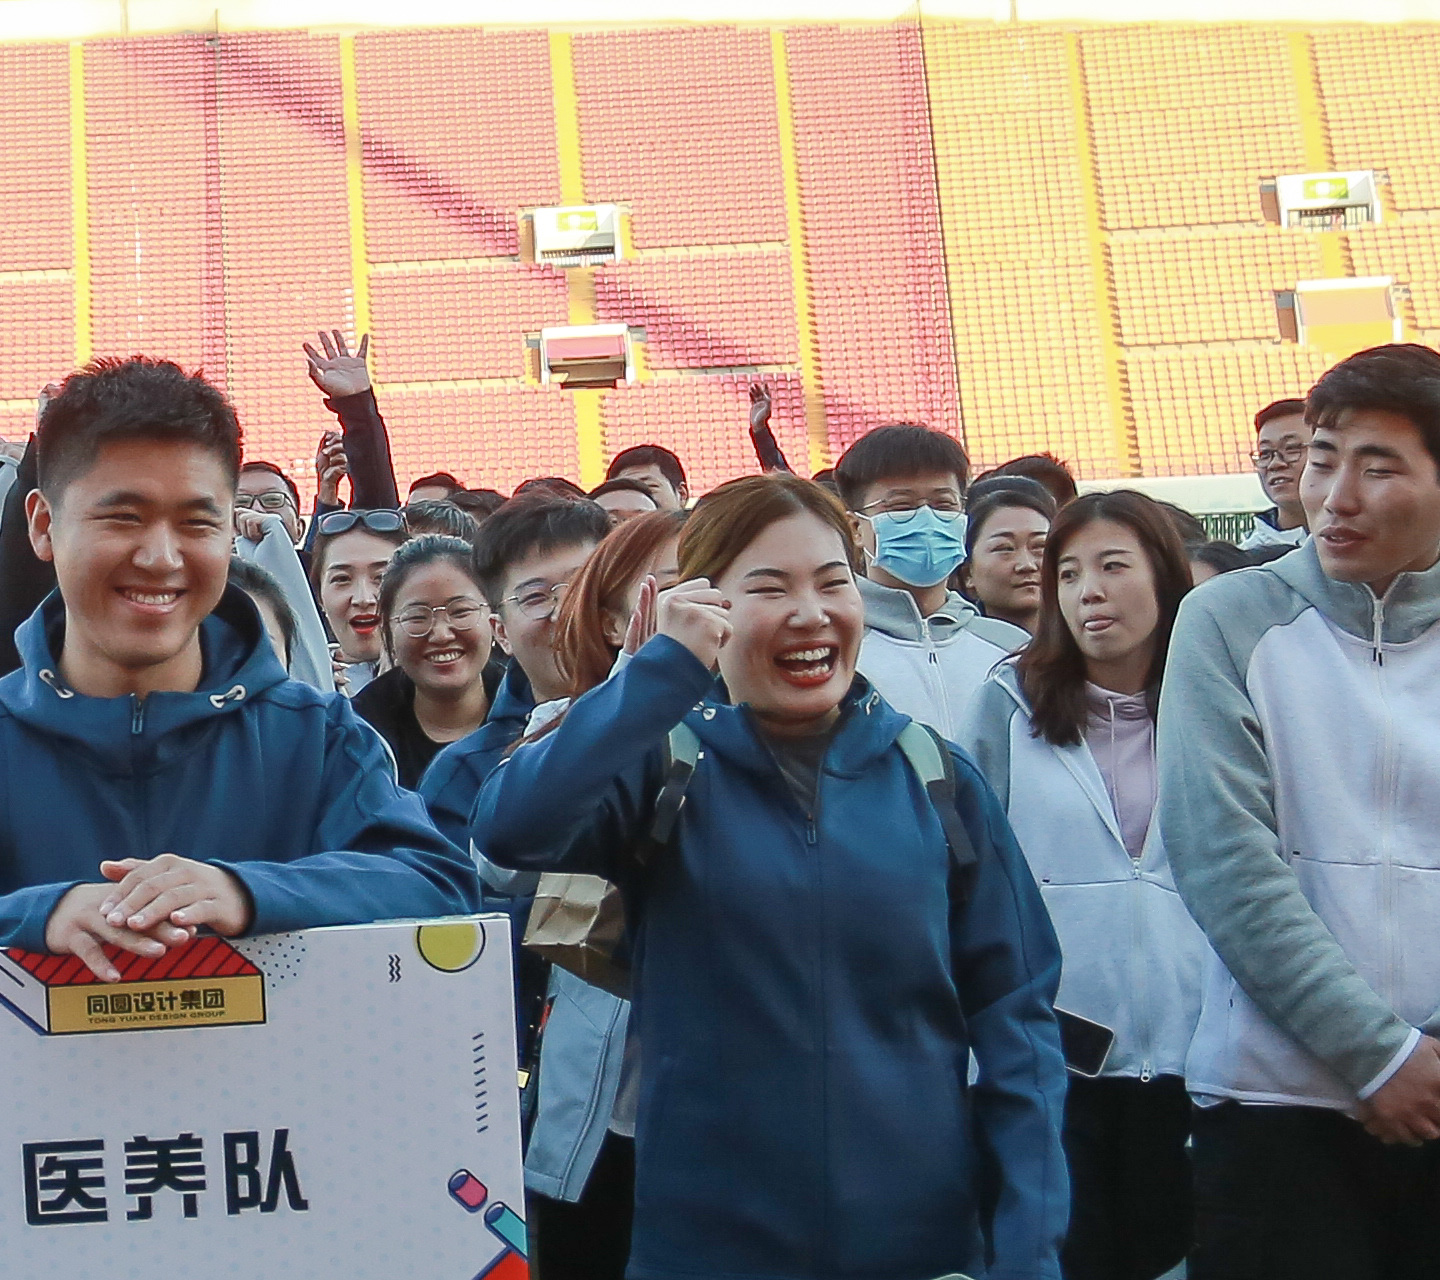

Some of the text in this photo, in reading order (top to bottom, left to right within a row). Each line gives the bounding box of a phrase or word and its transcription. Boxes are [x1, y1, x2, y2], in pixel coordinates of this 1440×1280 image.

[87, 988, 225, 1015] 同圆设计集团
[120, 1015, 146, 1023] YUAN
[149, 1013, 187, 1021] DESIGN
[190, 1010, 226, 1018] GROUP
[22, 1128, 309, 1226] 医养队
